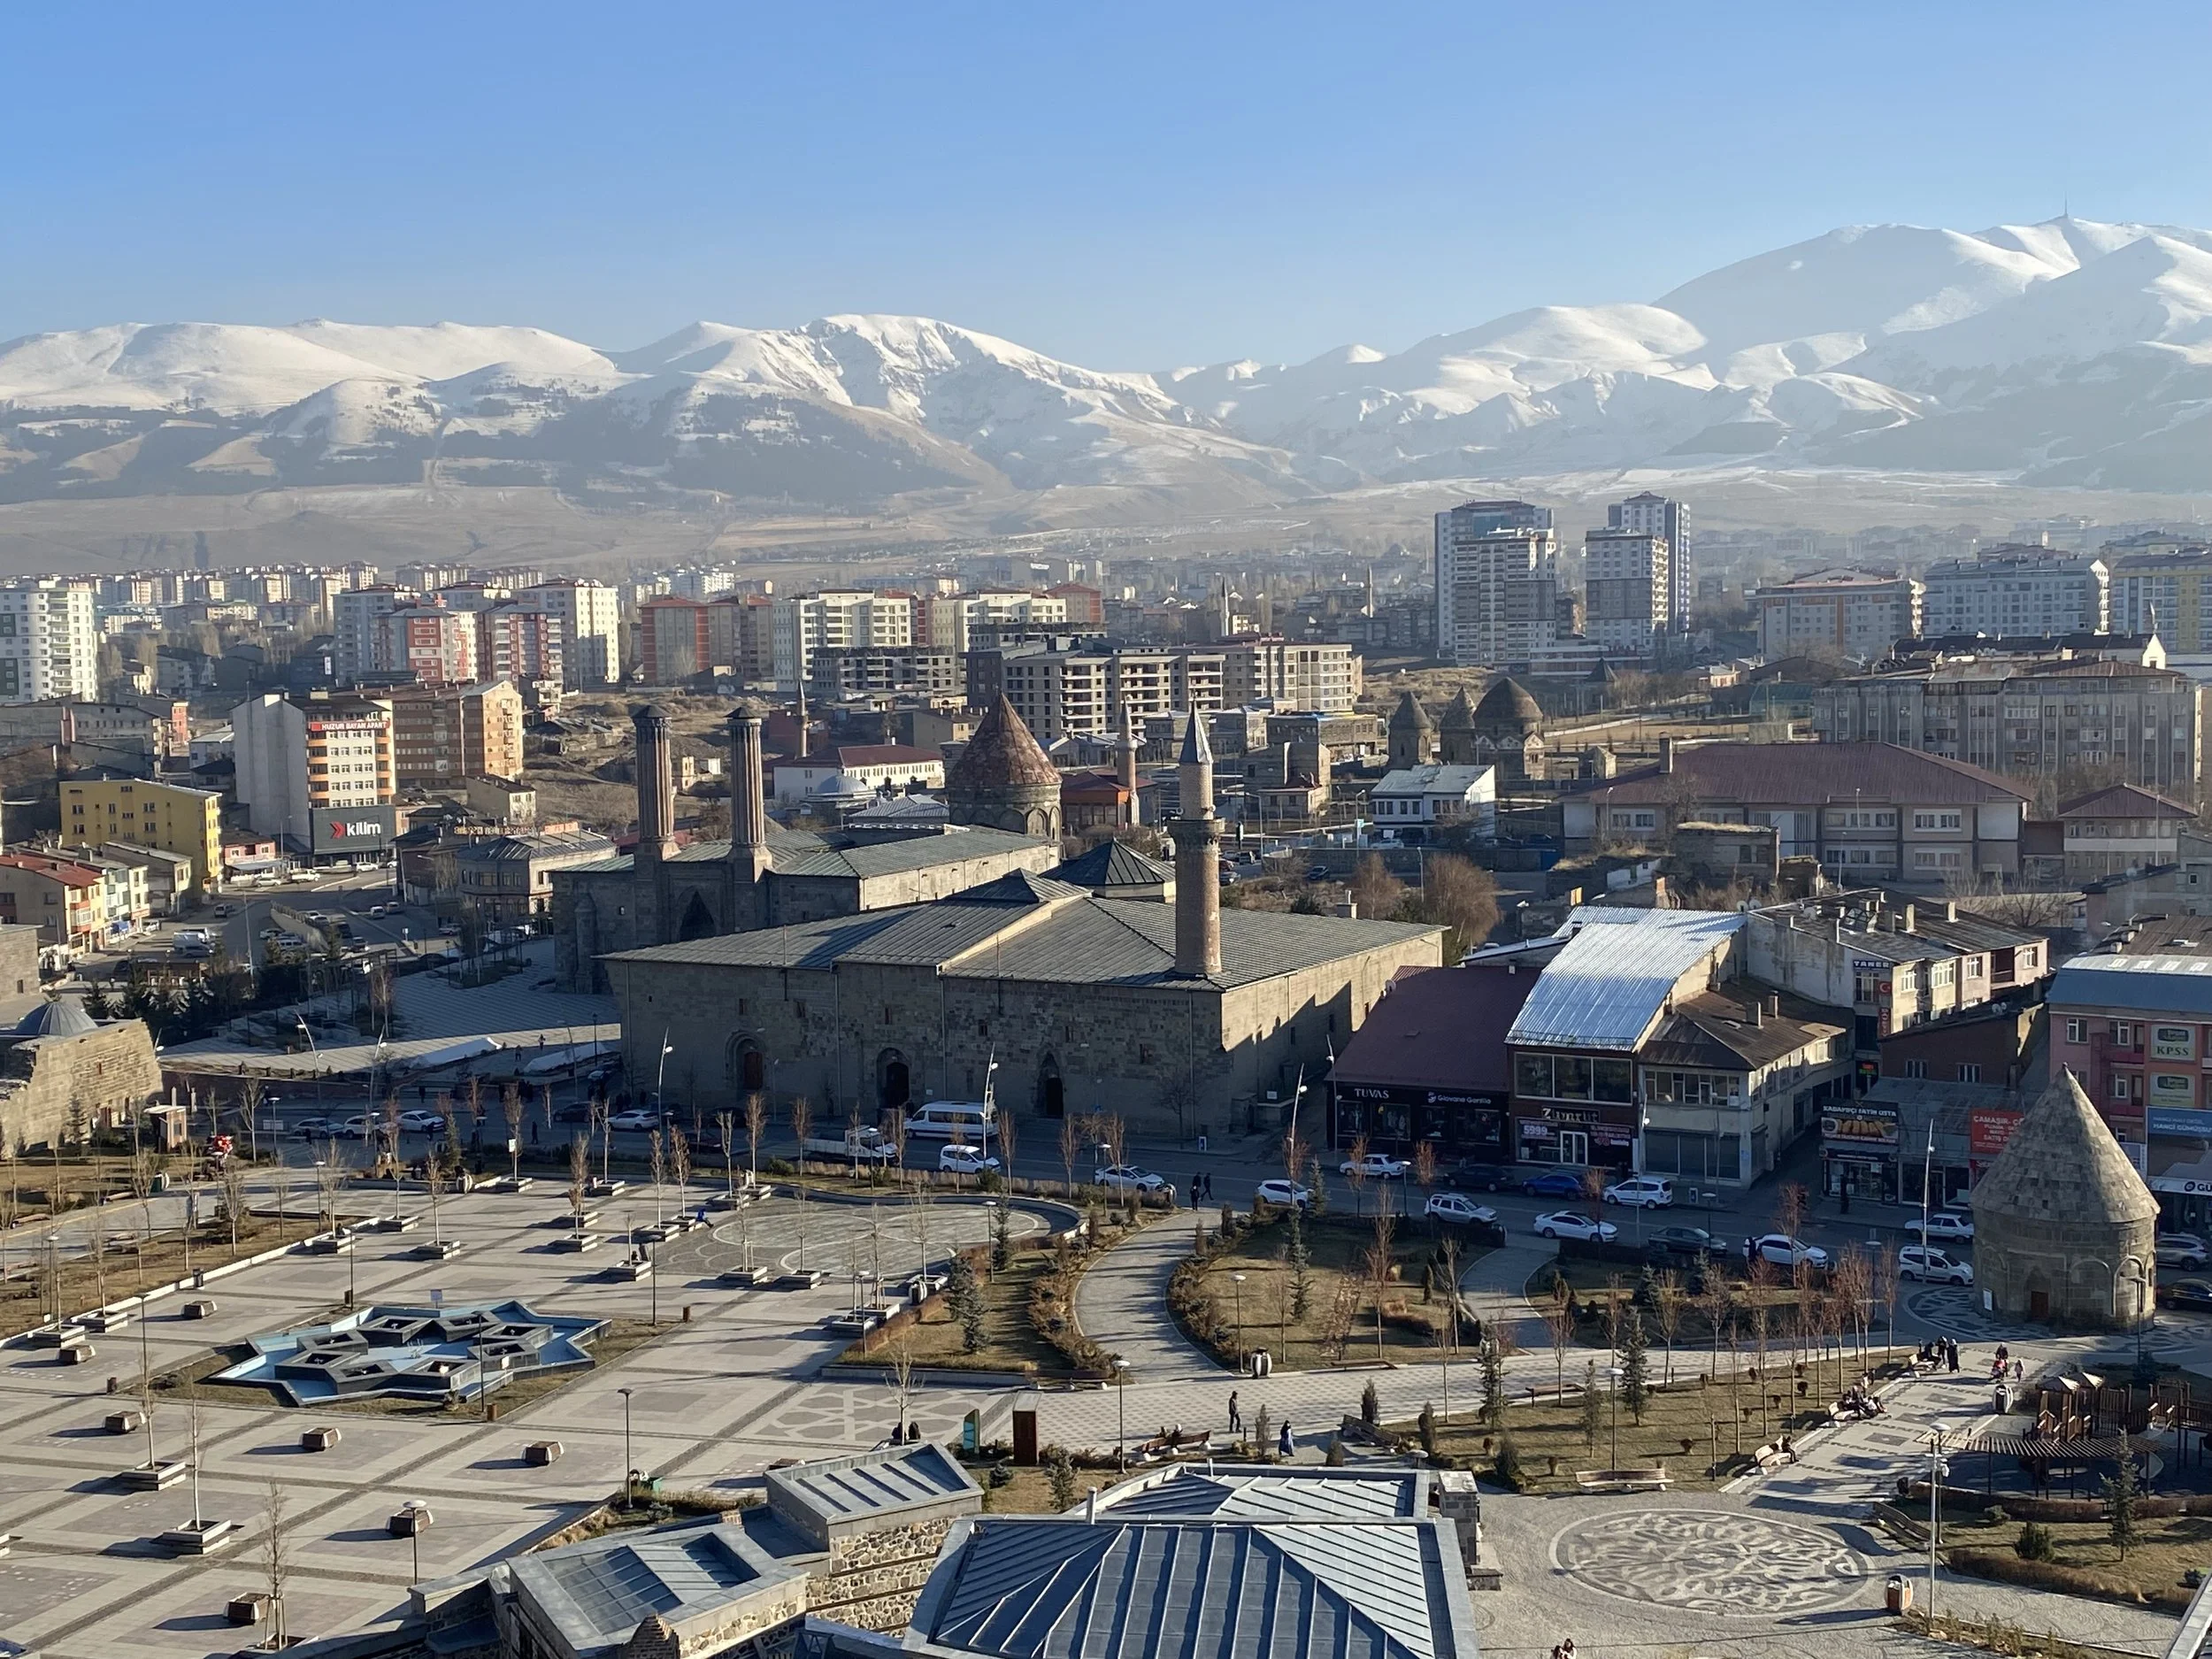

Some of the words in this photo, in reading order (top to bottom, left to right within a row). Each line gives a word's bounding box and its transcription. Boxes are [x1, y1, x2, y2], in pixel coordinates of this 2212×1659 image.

[346, 821, 381, 837] kilim
[2156, 1046, 2189, 1056] KPSS
[1355, 1088, 1390, 1099] TUVAS
[1523, 1125, 1548, 1135] 5999
